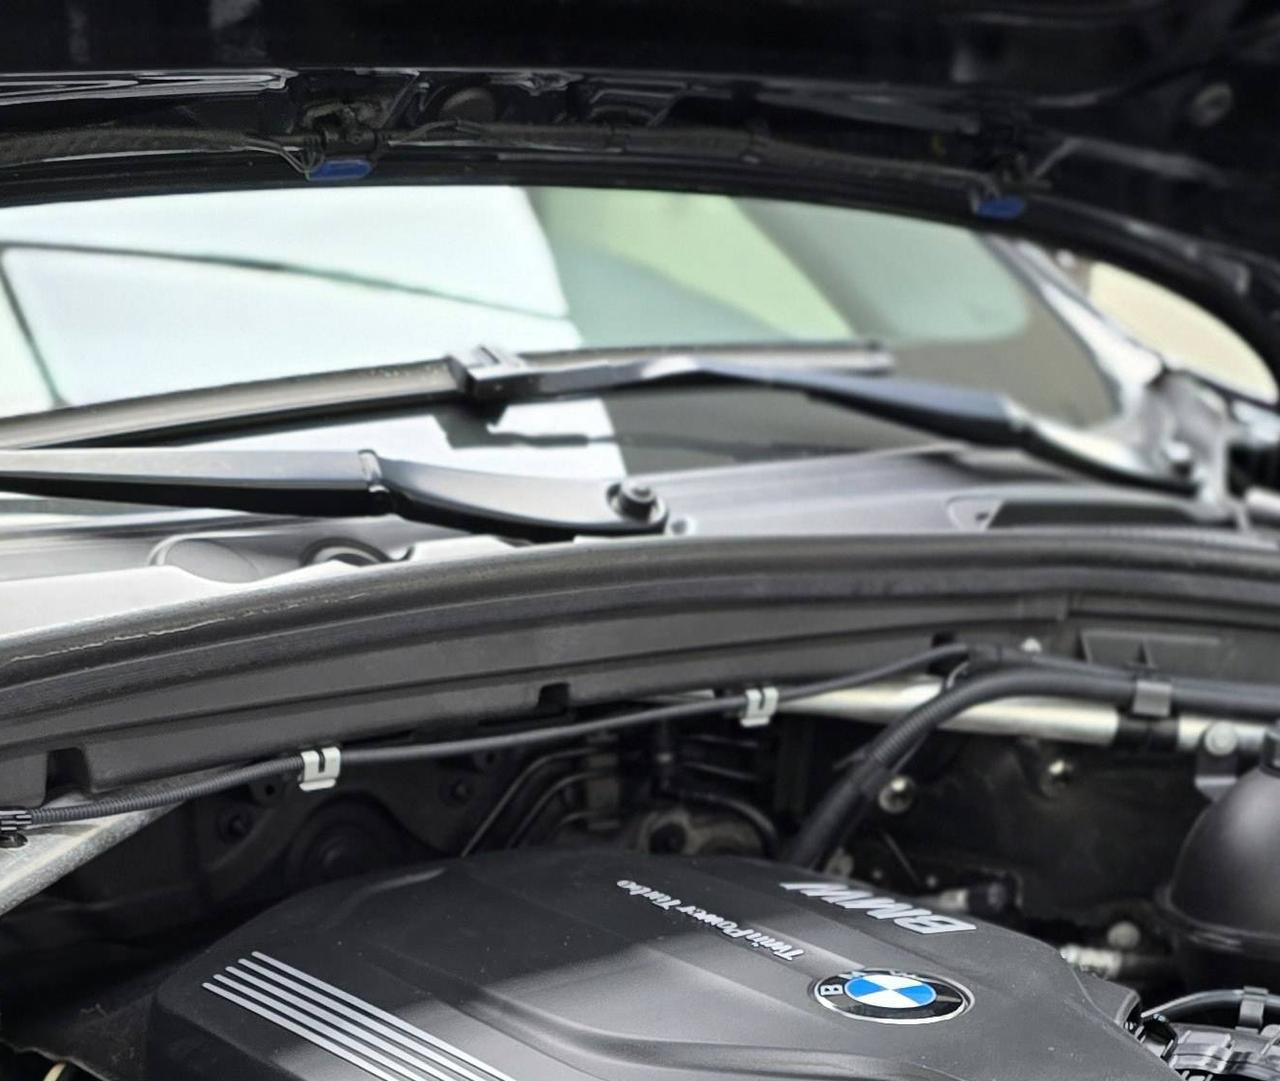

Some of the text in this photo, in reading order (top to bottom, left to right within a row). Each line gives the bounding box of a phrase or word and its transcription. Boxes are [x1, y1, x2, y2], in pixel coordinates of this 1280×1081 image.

[616, 879, 805, 961] TwinPower Turbo
[779, 882, 977, 934] BMW
